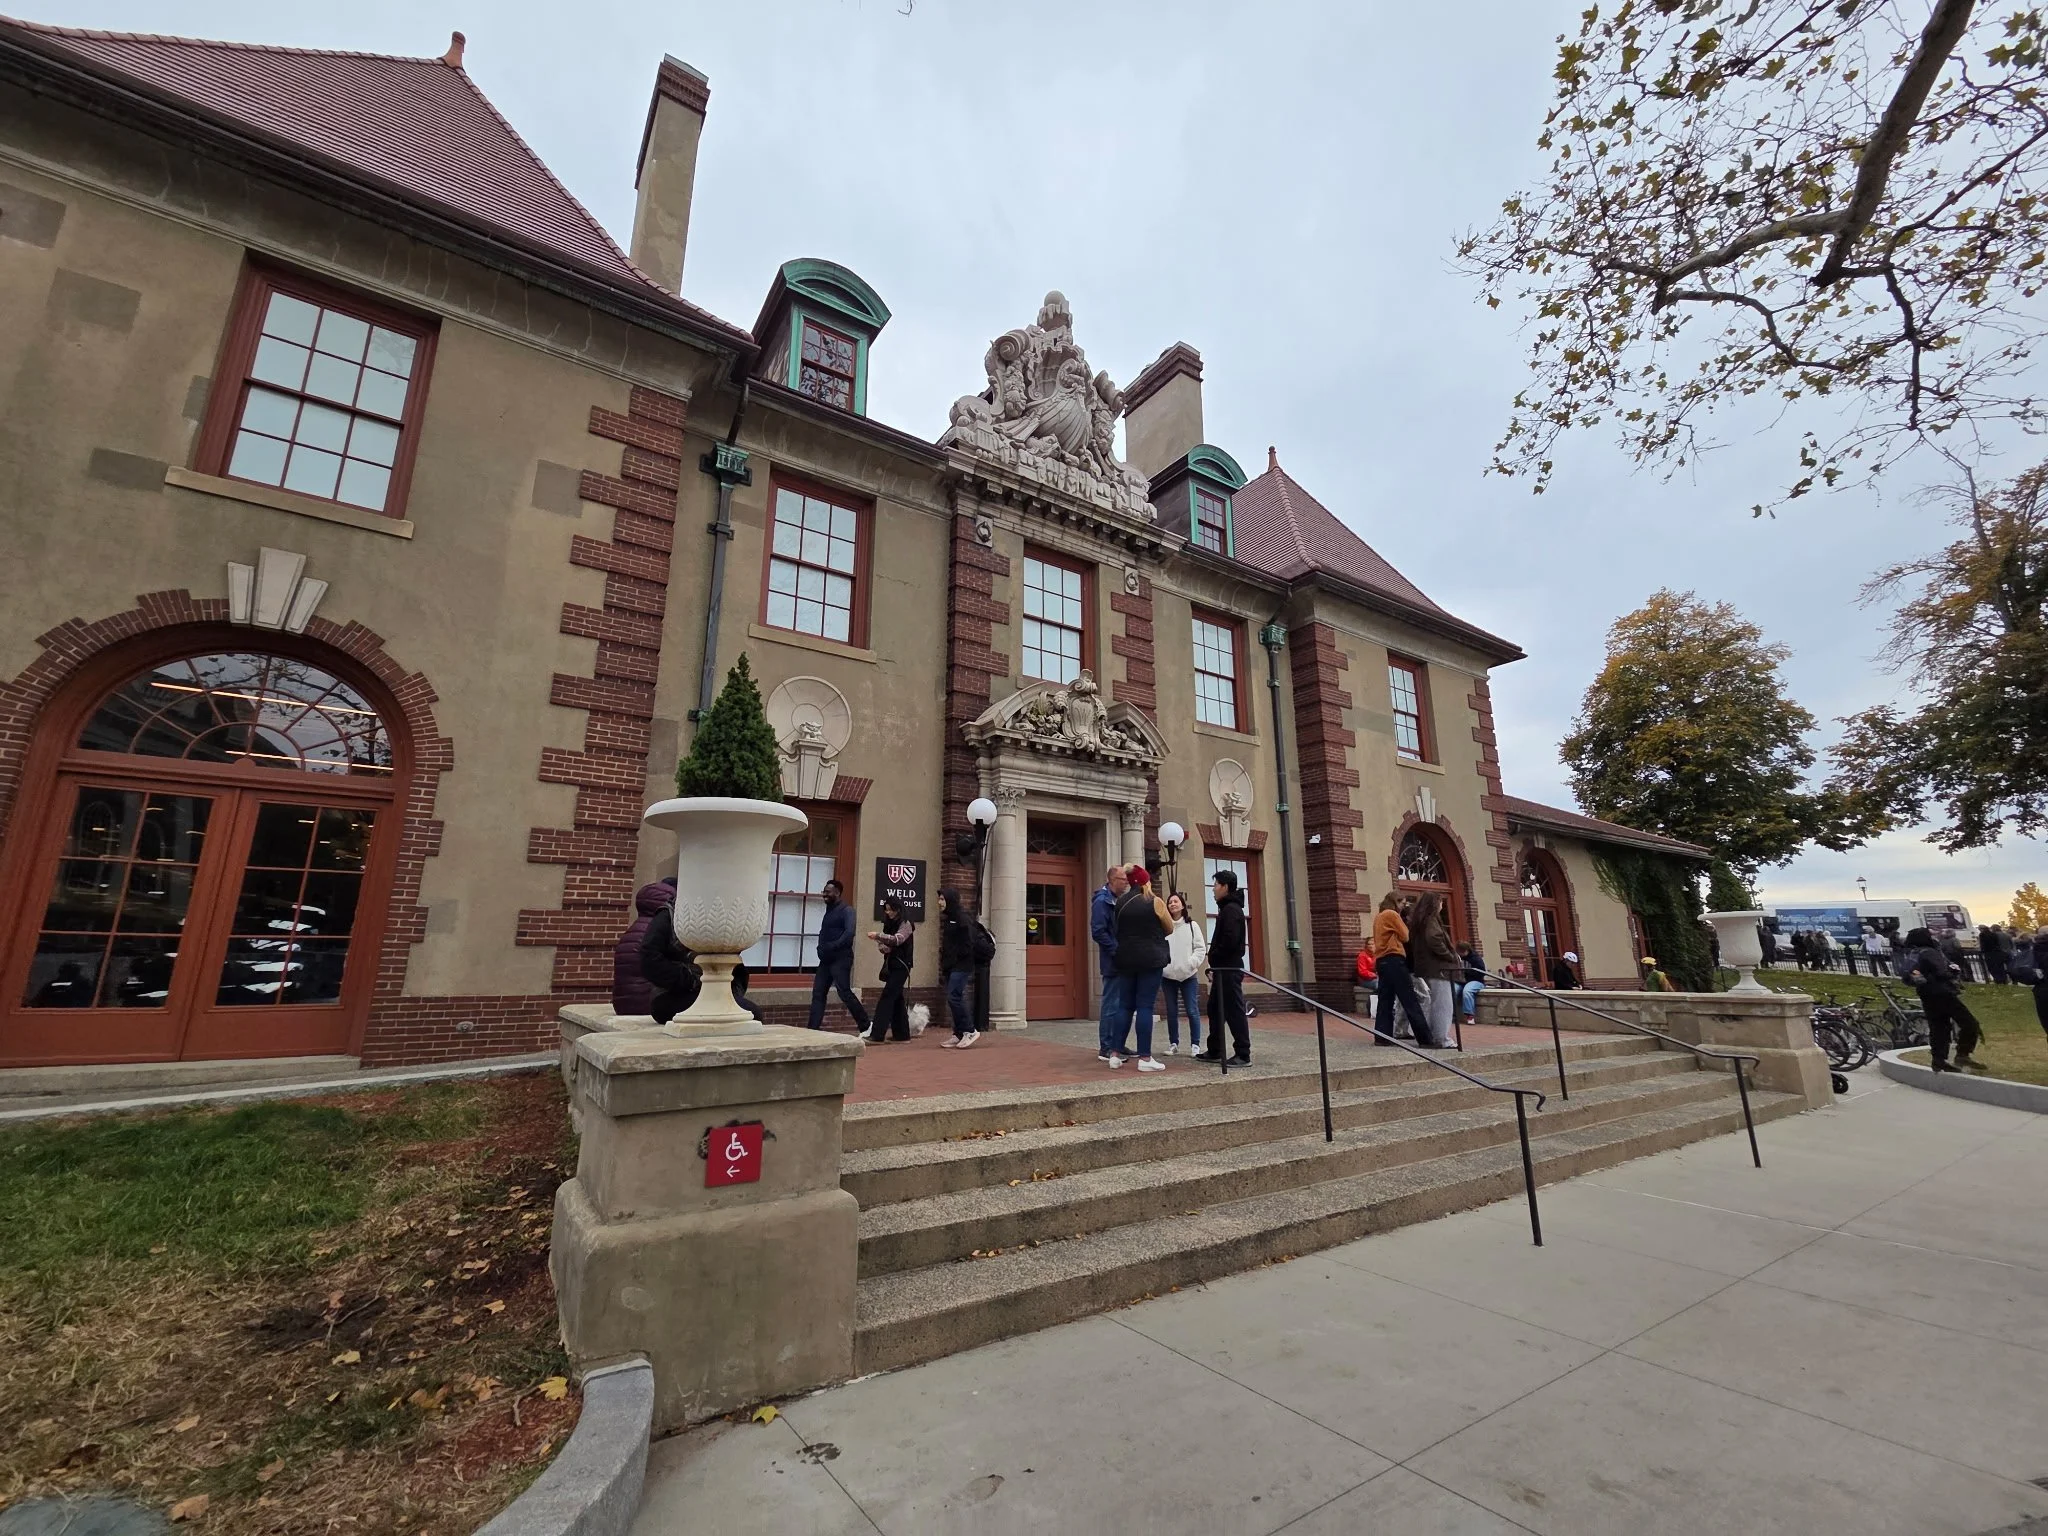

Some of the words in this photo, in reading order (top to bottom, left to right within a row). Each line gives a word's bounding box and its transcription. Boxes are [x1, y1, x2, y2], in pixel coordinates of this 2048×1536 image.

[890, 866, 899, 878] H
[886, 888, 916, 898] WELD
[879, 899, 922, 908] BOUSE
